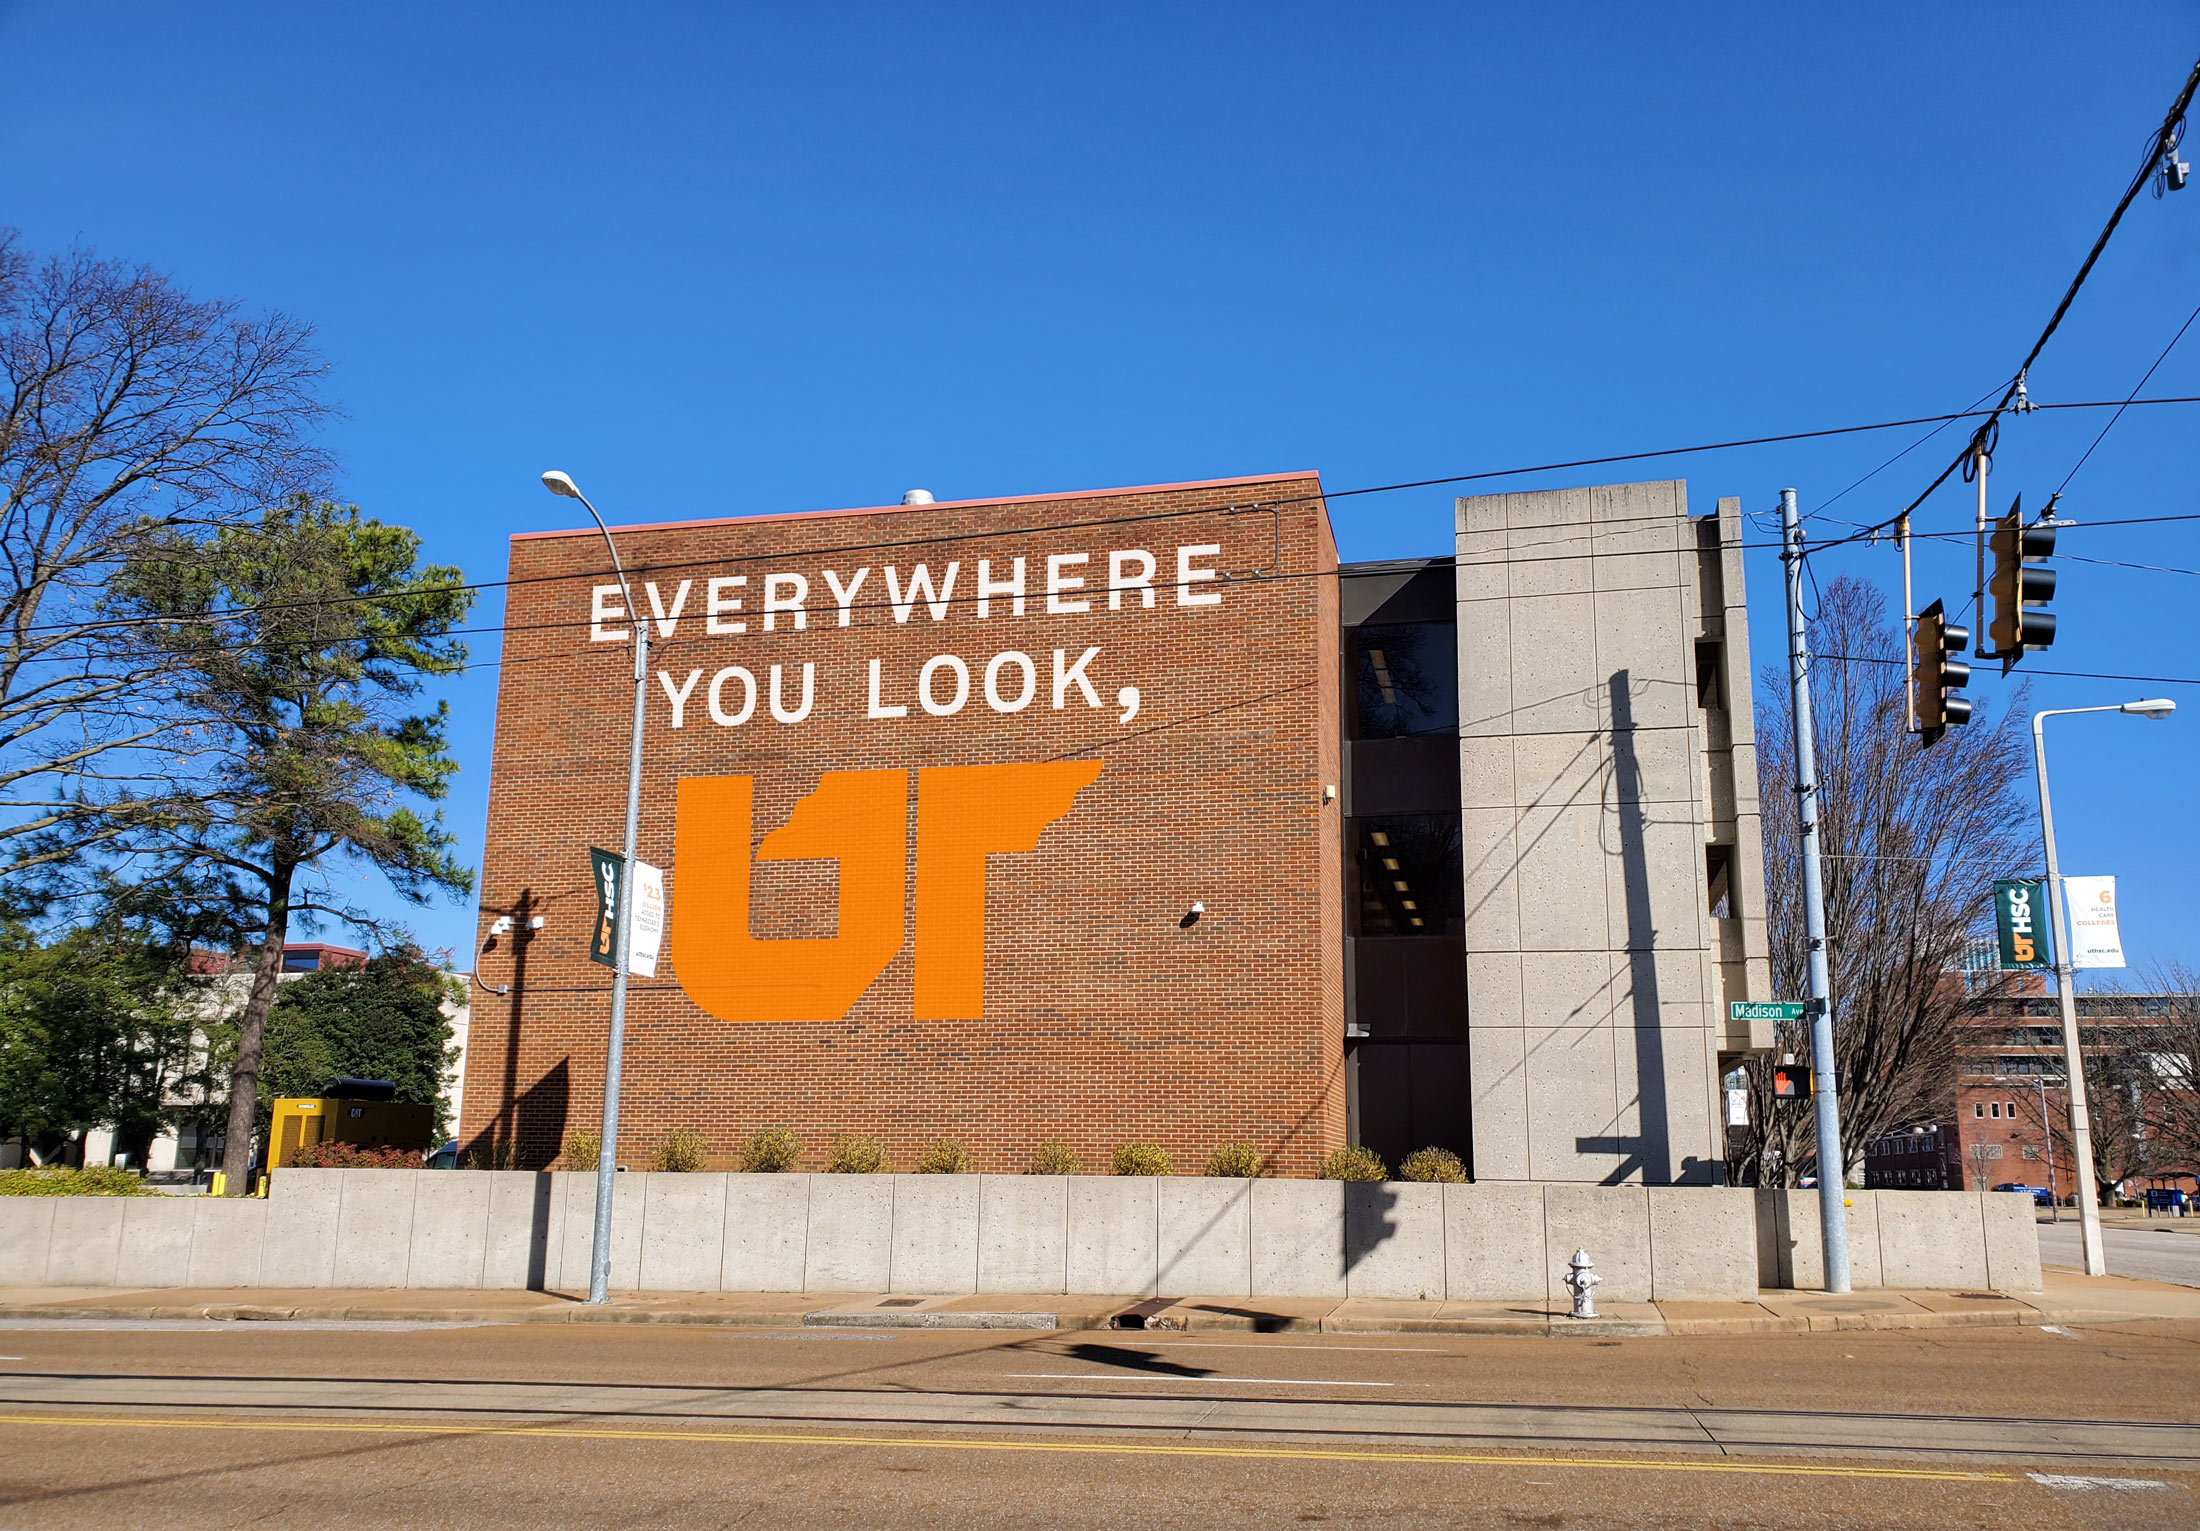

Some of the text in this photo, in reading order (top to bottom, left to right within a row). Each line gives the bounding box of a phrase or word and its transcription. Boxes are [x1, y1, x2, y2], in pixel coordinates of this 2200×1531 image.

[589, 543, 1222, 642] EVERYWHERE
[657, 646, 1141, 729] YOU LOOK,
[671, 759, 1105, 1022] UT
[2099, 890, 2112, 904] 6
[1735, 1004, 1804, 1018] Madison Ave
[351, 1108, 362, 1118] CAT
